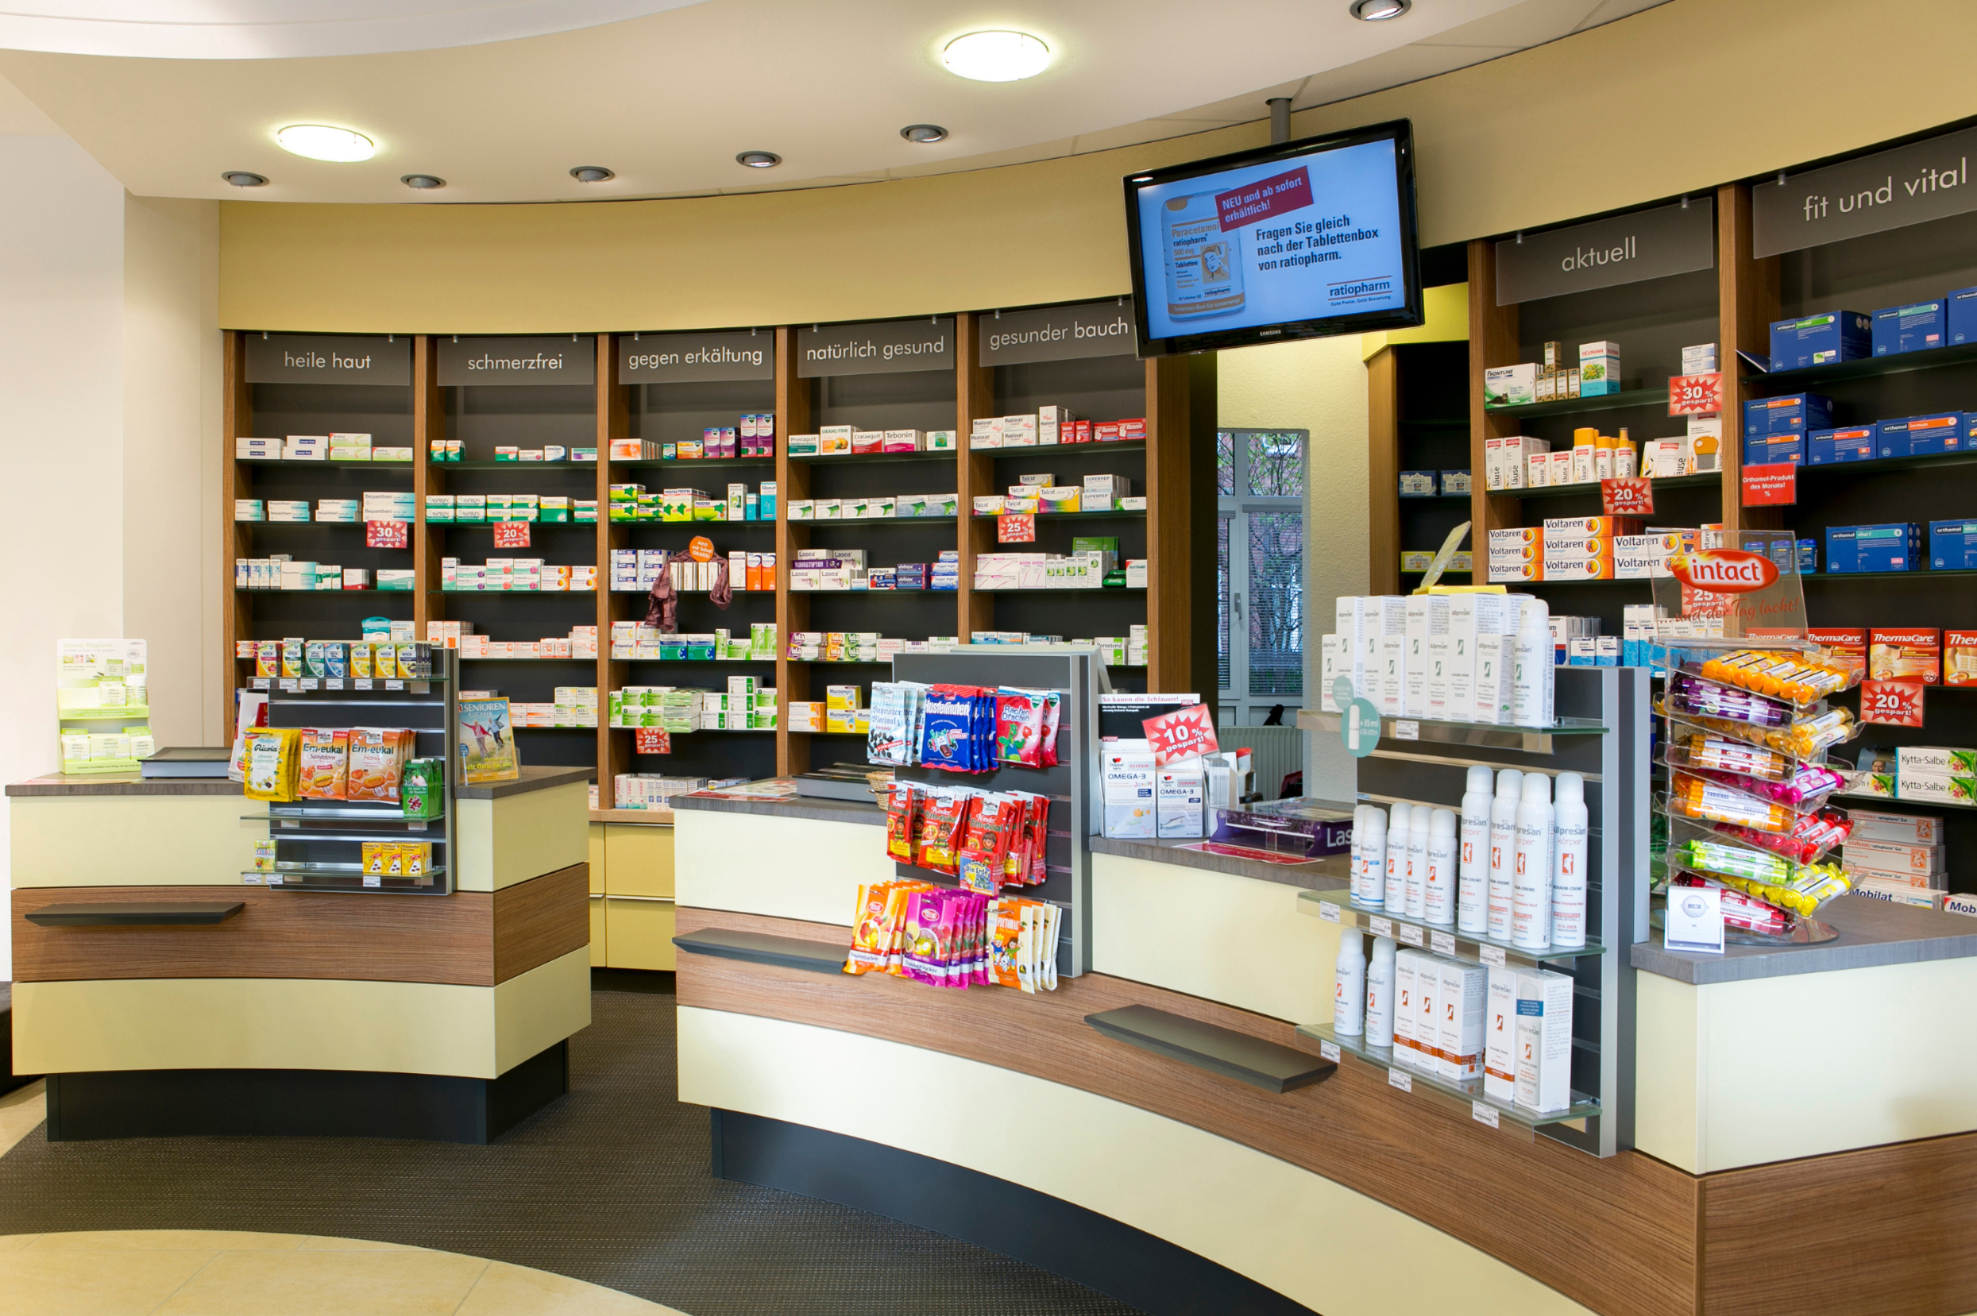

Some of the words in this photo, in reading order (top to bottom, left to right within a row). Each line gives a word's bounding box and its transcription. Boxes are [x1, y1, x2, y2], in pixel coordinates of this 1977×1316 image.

[1222, 195, 1241, 210] NEU
[1244, 189, 1260, 203] und
[1262, 186, 1273, 197] ab
[1275, 177, 1302, 193] sofort
[1803, 196, 1829, 222] fit
[1839, 176, 1892, 215] und
[1904, 157, 1967, 197] vital
[1225, 200, 1270, 222] erhältlich!
[1171, 221, 1219, 238] Paracetamol
[1256, 227, 1291, 241] Fragen
[1295, 222, 1312, 234] Sie
[1316, 215, 1350, 233] gleich
[1258, 242, 1282, 256] nach
[1286, 240, 1303, 252] der
[1306, 229, 1379, 248] Tablettenbox
[1562, 236, 1636, 272] aktuell
[1258, 260, 1276, 271] von
[1280, 251, 1341, 267] ratiopharm.
[1330, 281, 1390, 296] ratiopharm
[990, 324, 1069, 350] gesunder
[1075, 317, 1128, 338] bauch
[807, 340, 877, 361] natürlich
[883, 336, 944, 360] gesund
[284, 352, 326, 369] heile
[332, 352, 372, 369] haut
[467, 353, 563, 371] schmerzfrei
[628, 350, 680, 370] gegen
[685, 346, 763, 367] erkältung
[1683, 387, 1702, 399] 30
[1682, 398, 1713, 406] gespart!
[1743, 474, 1794, 483] Orthomol-Produkt
[1614, 489, 1632, 500] 20
[1007, 523, 1020, 532] 25
[1546, 520, 1583, 528] Voltaren
[377, 528, 392, 537] 30
[503, 529, 517, 538] 20
[1546, 540, 1583, 549] Voltaren
[1616, 536, 1658, 546] Voltaren
[1546, 561, 1583, 569] Voltaren
[1617, 558, 1660, 568] Voltaren
[1692, 559, 1760, 581] intact
[1694, 590, 1713, 600] 25
[1707, 608, 1728, 619] der
[1731, 598, 1756, 620] Tag
[1761, 598, 1799, 615] lacht!
[1808, 634, 1861, 642] ThermaCare
[1874, 634, 1934, 642] ThermaCare
[464, 702, 506, 712] SENIOREN
[1876, 695, 1900, 708] 20
[1903, 702, 1911, 710] %
[1005, 706, 1029, 715] Rachen
[1875, 708, 1912, 716] gespart!
[1002, 713, 1030, 722] Drachen
[1164, 725, 1189, 743] 10
[1192, 728, 1202, 736] %
[254, 744, 278, 752] Ricola
[303, 743, 343, 754] Em-eukal
[352, 744, 394, 754] Em-eukal
[1166, 736, 1204, 753] gespart!
[1901, 755, 1946, 765] Kytta-Salbe
[1901, 780, 1946, 792] Kytta-Salbe
